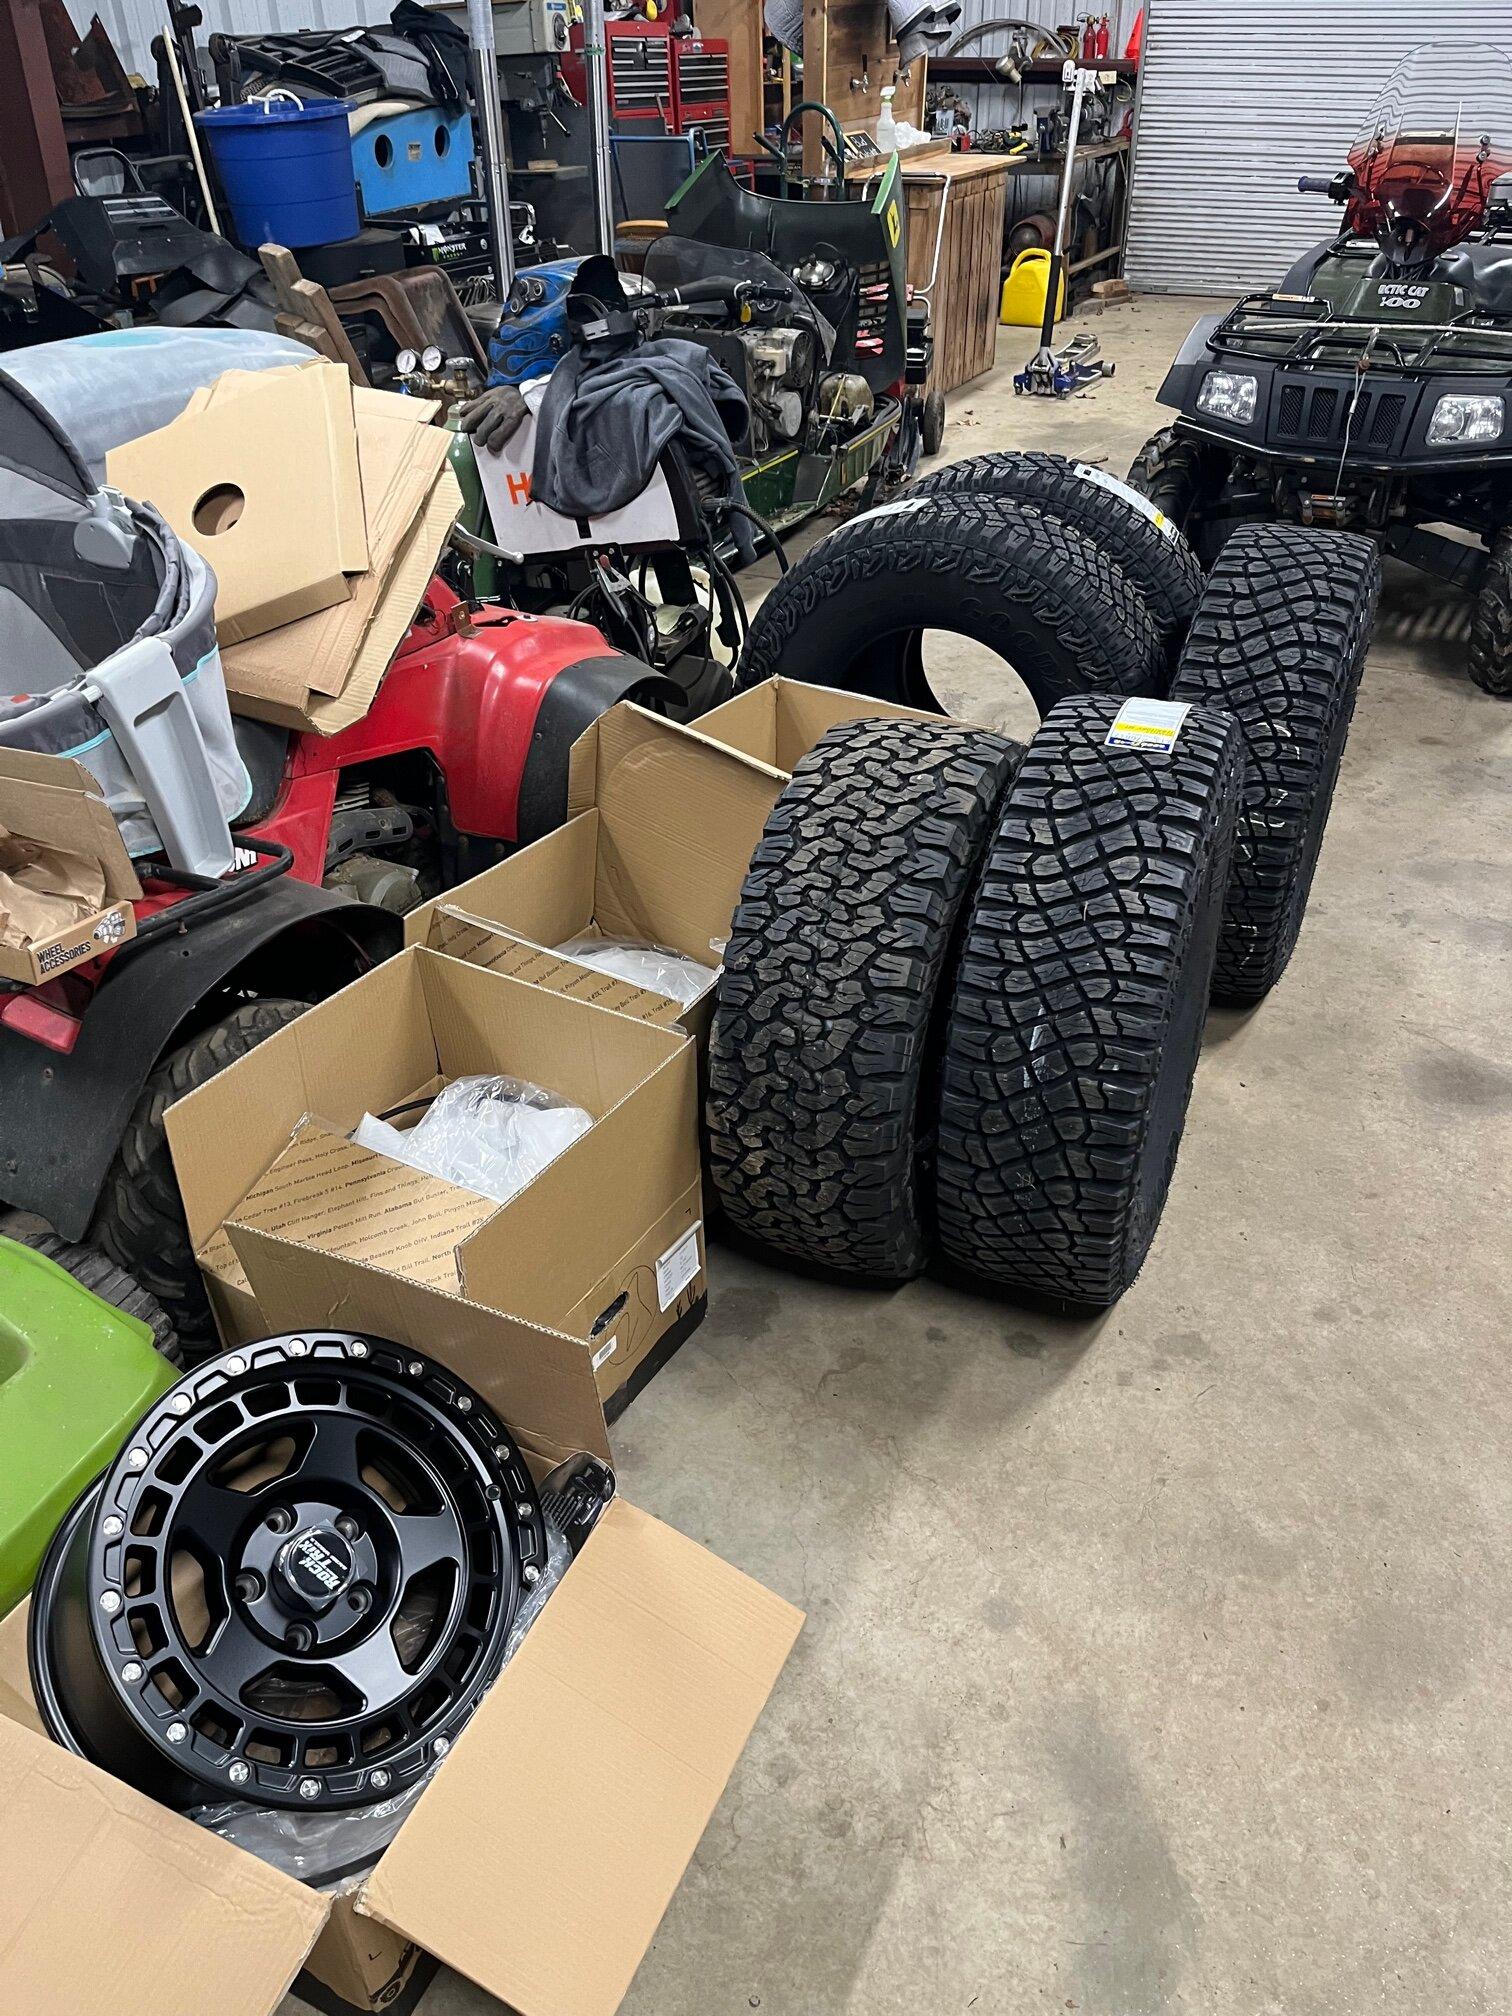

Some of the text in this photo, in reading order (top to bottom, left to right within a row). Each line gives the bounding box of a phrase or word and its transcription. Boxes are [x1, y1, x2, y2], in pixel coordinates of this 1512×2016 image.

[1408, 285, 1429, 297] CAT
[36, 942, 65, 964] WHEEL
[40, 941, 92, 975] ACCESSORIES
[344, 1170, 387, 1188] Pennsylvania
[245, 1188, 274, 1201] Michigan
[270, 1222, 287, 1232] Utah
[327, 1199, 355, 1213] Elephant
[306, 1227, 332, 1239] Virginia
[384, 1200, 412, 1214] Alabama
[359, 1229, 388, 1243] Holcomb
[430, 1228, 455, 1240] Indiana
[455, 1222, 470, 1231] Trail
[431, 1250, 453, 1261] North
[425, 1274, 442, 1284] Rock
[298, 1556, 341, 1591] ROCK
